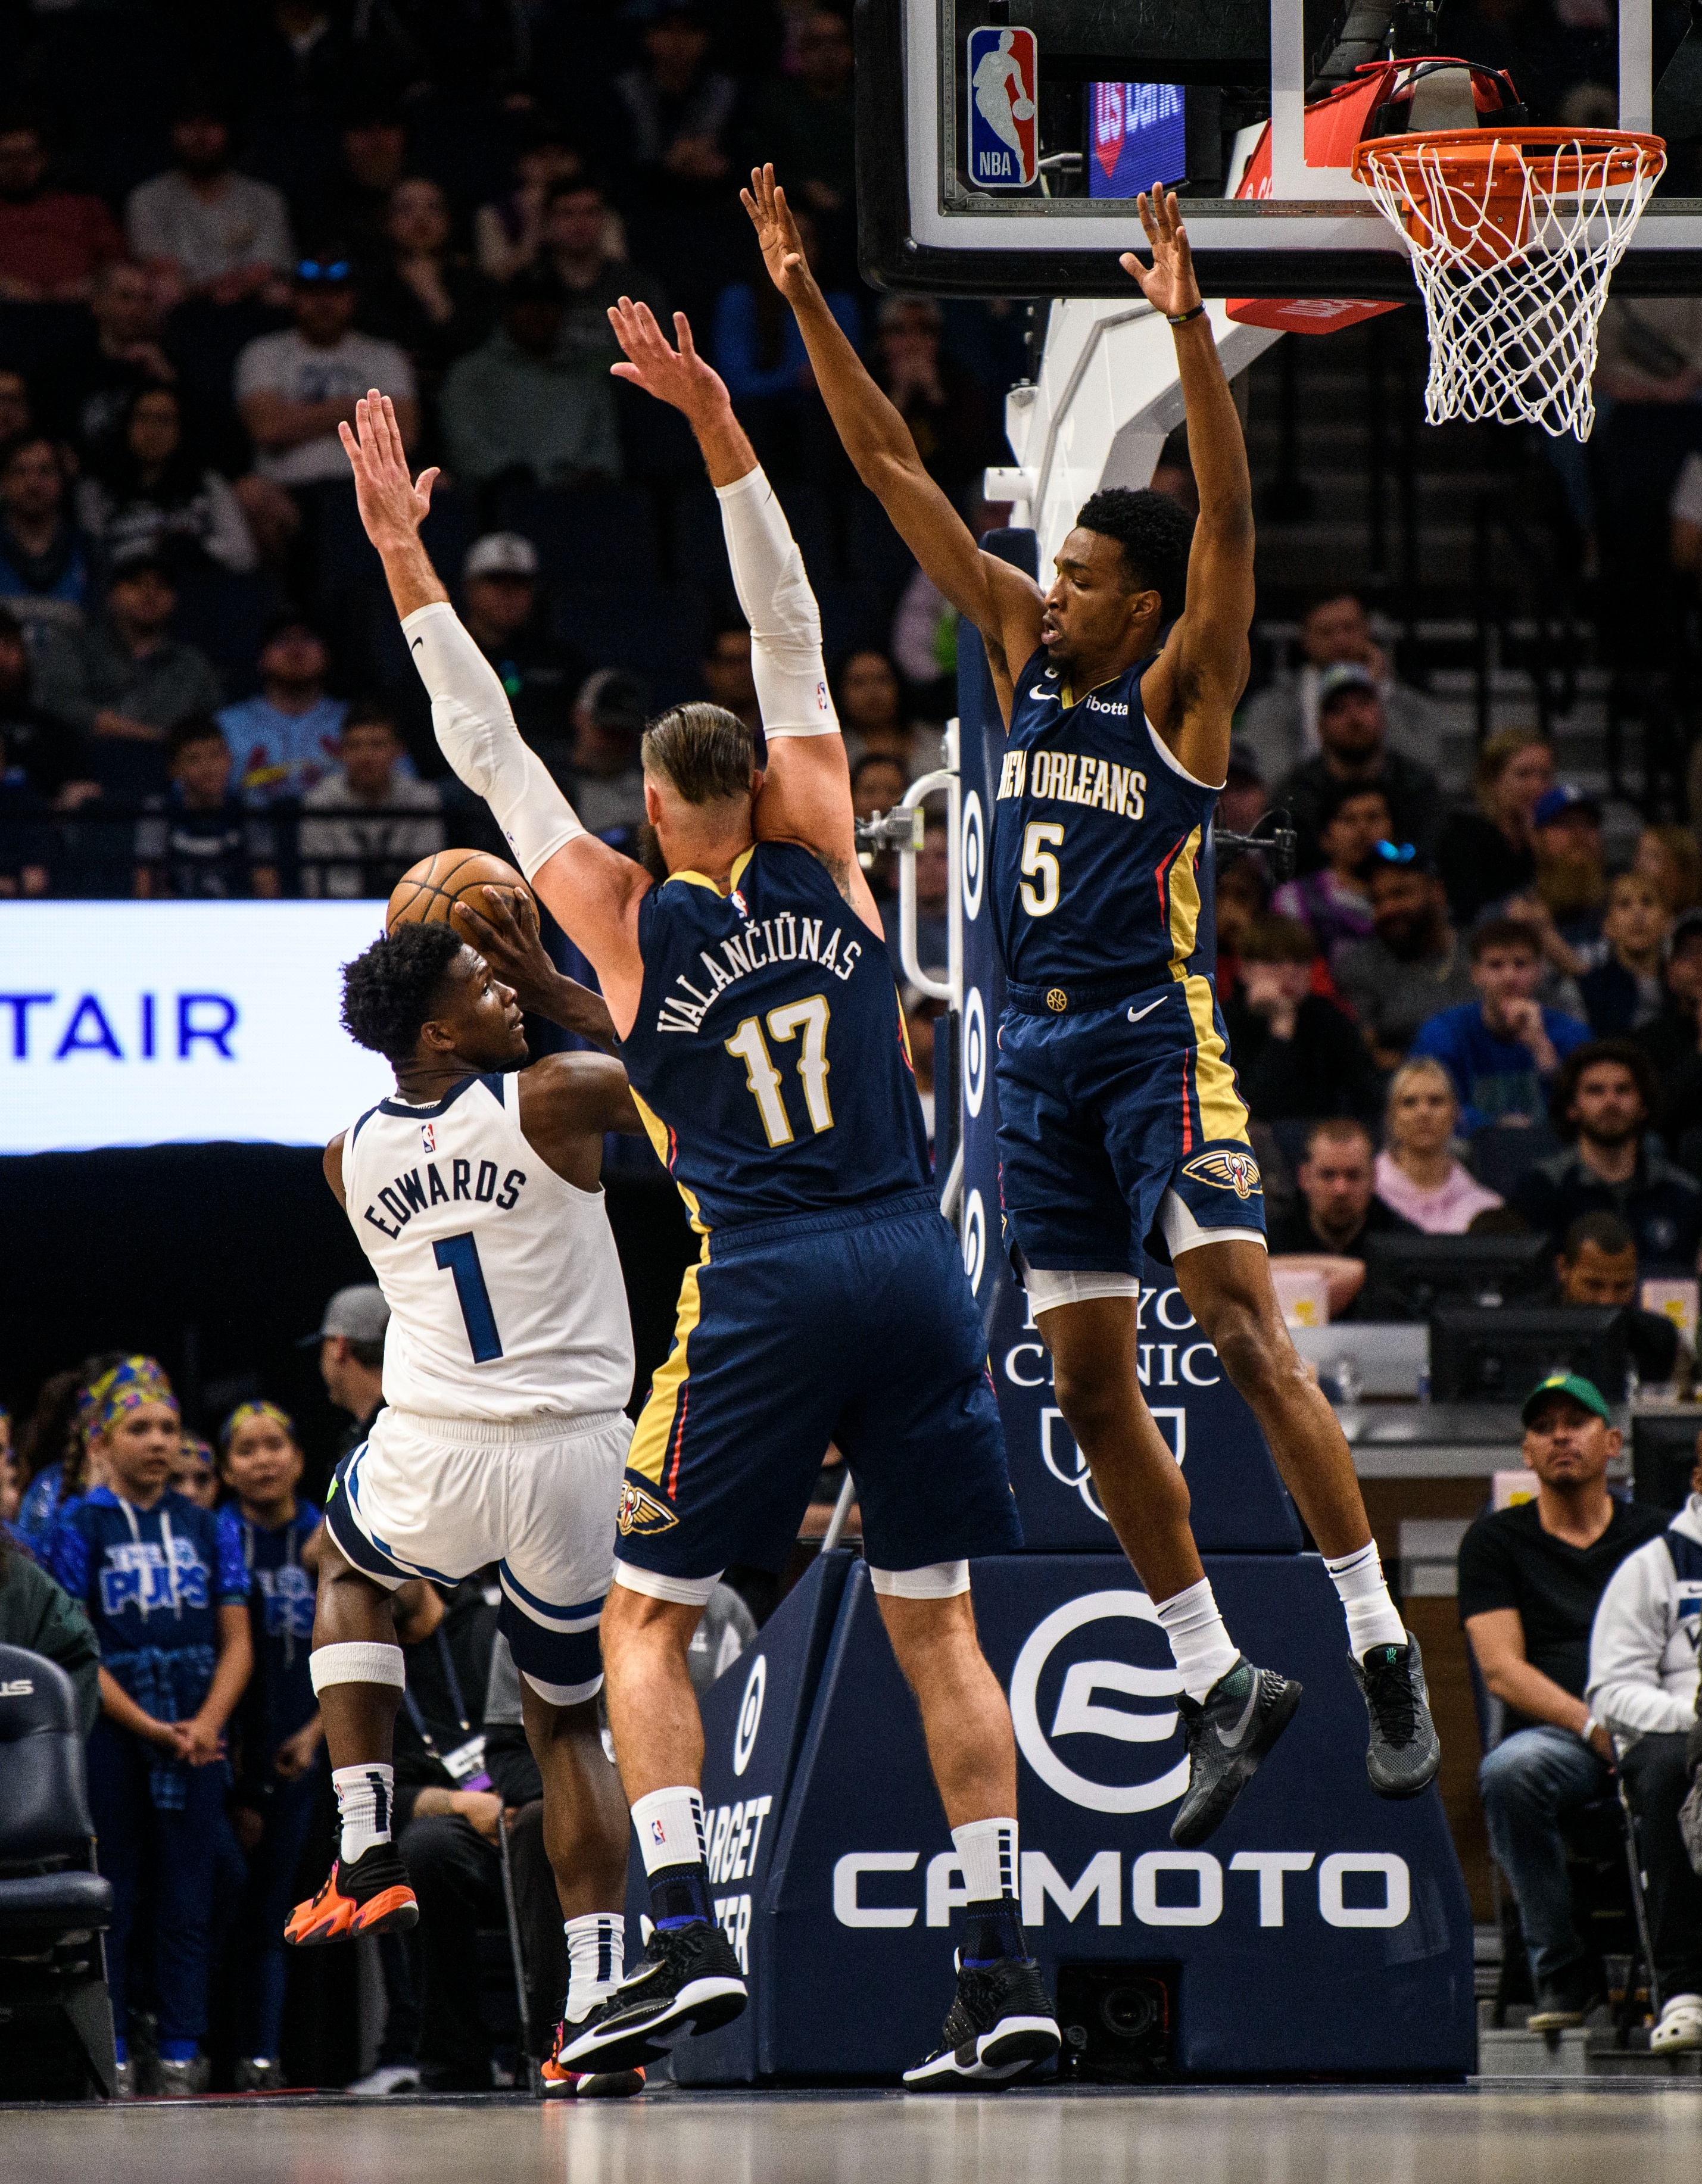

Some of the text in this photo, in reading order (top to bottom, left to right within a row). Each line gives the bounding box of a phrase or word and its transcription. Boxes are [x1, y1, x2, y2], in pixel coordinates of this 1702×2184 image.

[980, 151, 1011, 176] NBA
[1086, 694, 1129, 716] ibotta
[1031, 750, 1147, 820] ORLEANS
[1020, 822, 1064, 917] 5
[656, 912, 862, 1034] VALANČIŪNAS
[0, 992, 239, 1060] TAIR
[724, 994, 834, 1148] 17
[364, 1159, 526, 1240] EDWARDS
[432, 1231, 504, 1364] 1
[1005, 1343, 1221, 1387] CNIC
